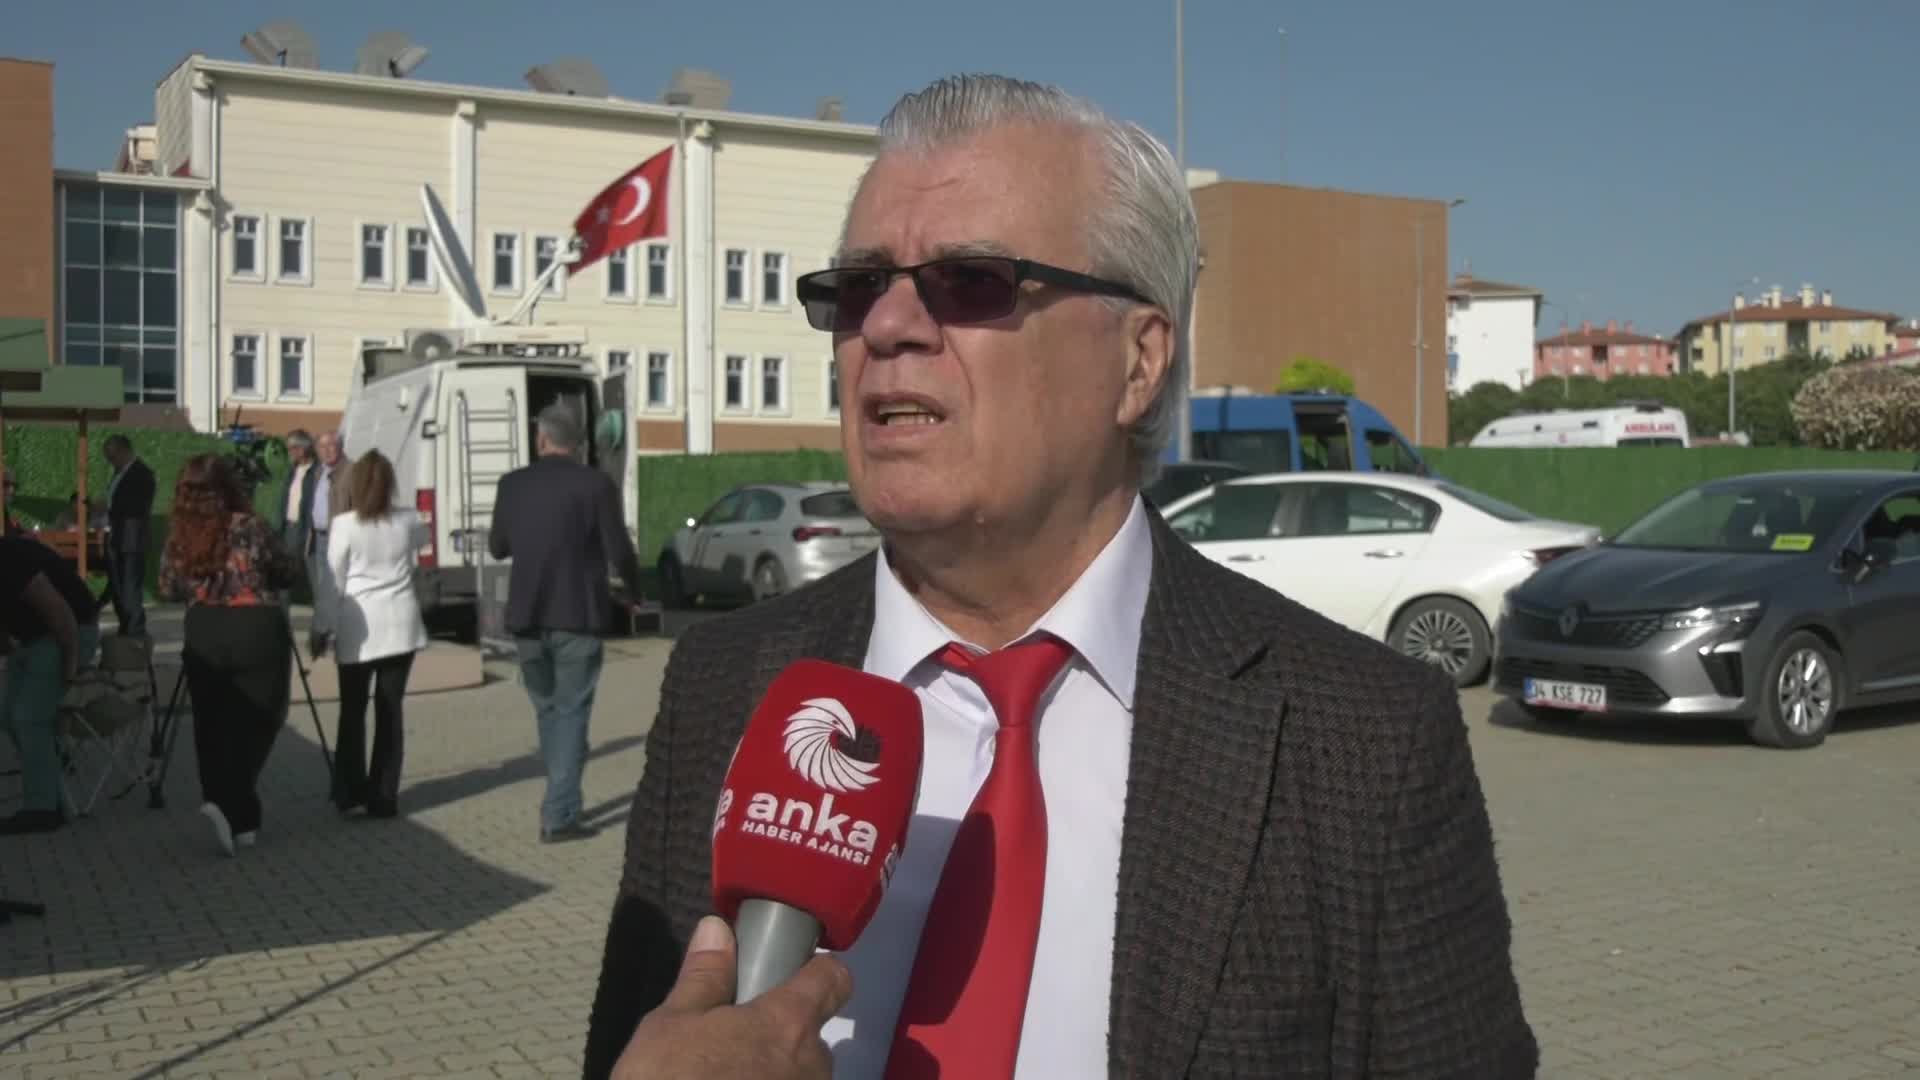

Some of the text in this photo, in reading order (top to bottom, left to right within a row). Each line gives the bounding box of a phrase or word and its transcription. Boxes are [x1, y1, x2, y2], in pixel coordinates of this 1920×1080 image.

[741, 820, 870, 865] HABER AJANSI
[747, 791, 878, 853] anka
